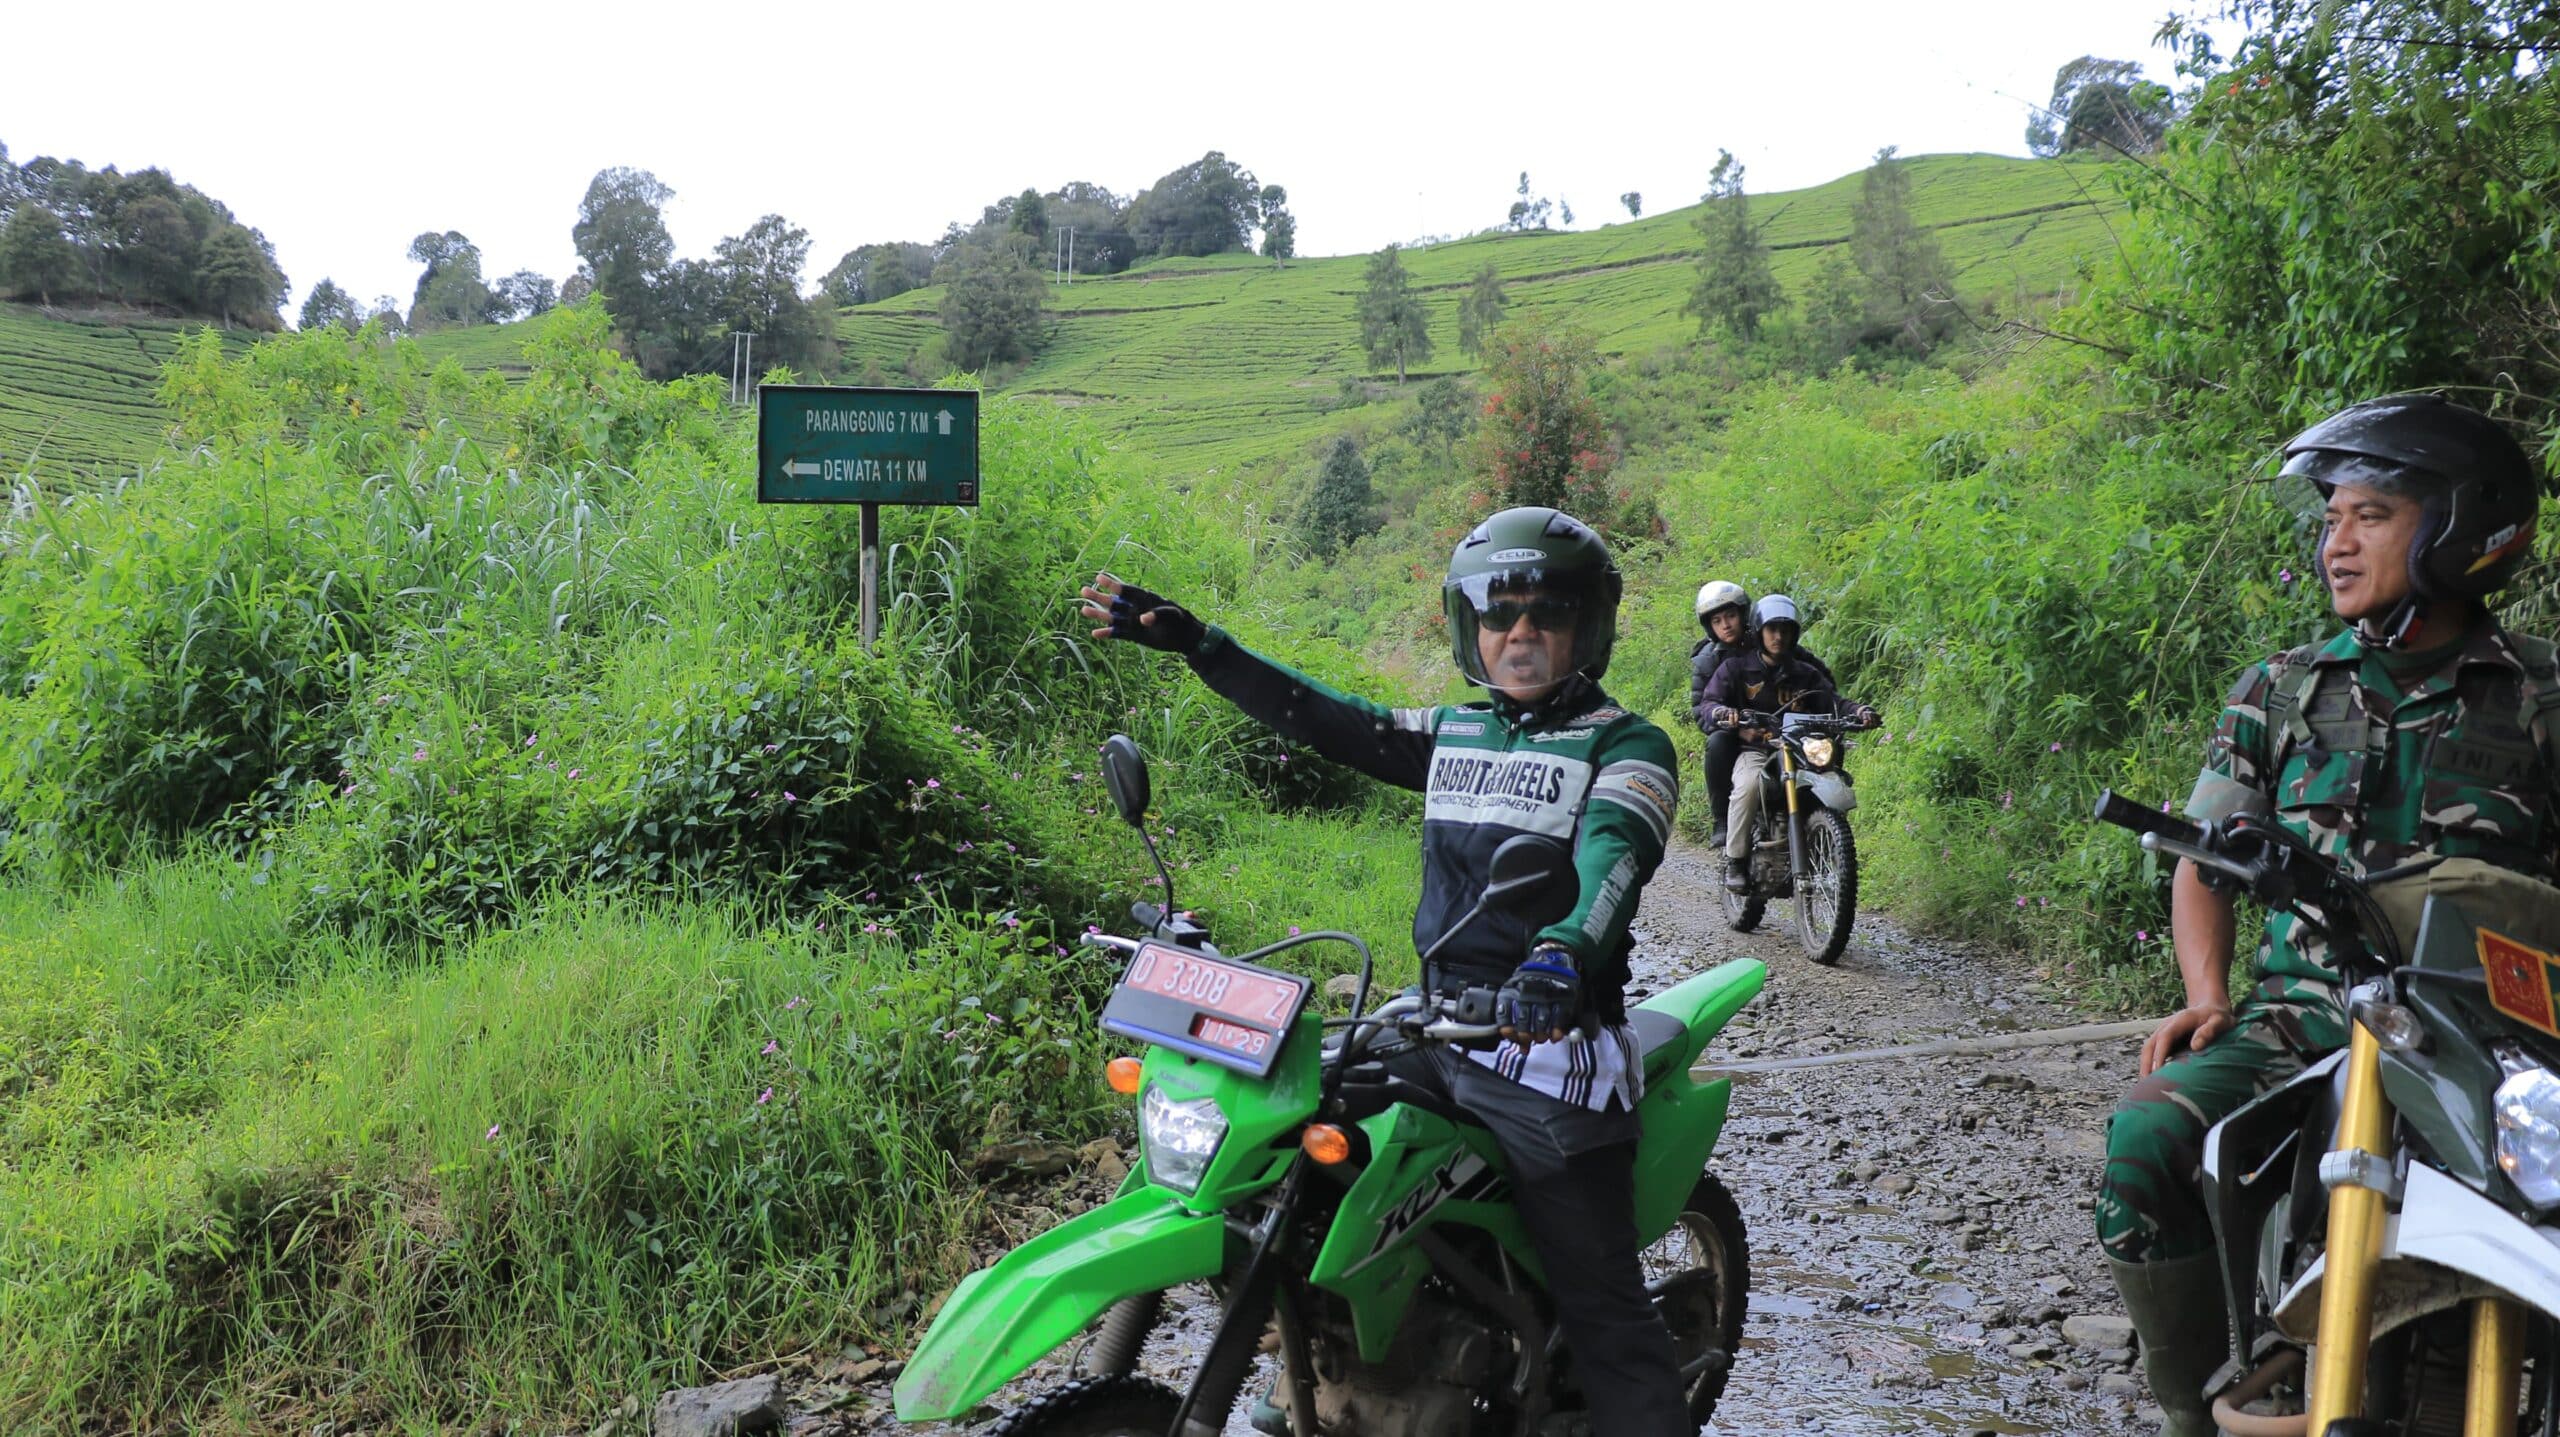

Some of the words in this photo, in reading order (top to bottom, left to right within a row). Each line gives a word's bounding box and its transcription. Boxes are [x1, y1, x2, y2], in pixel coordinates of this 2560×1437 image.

[806, 409, 895, 433] PARANGGONG
[899, 410, 907, 433] 7
[910, 411, 929, 434] KM
[823, 459, 881, 482] DEWATA
[886, 459, 901, 482] 11
[907, 460, 927, 482] KM
[1483, 795, 1543, 814] EQUIPMENT
[1132, 951, 1157, 983] D
[1163, 957, 1231, 1005] 3308
[1264, 986, 1290, 1022] Z
